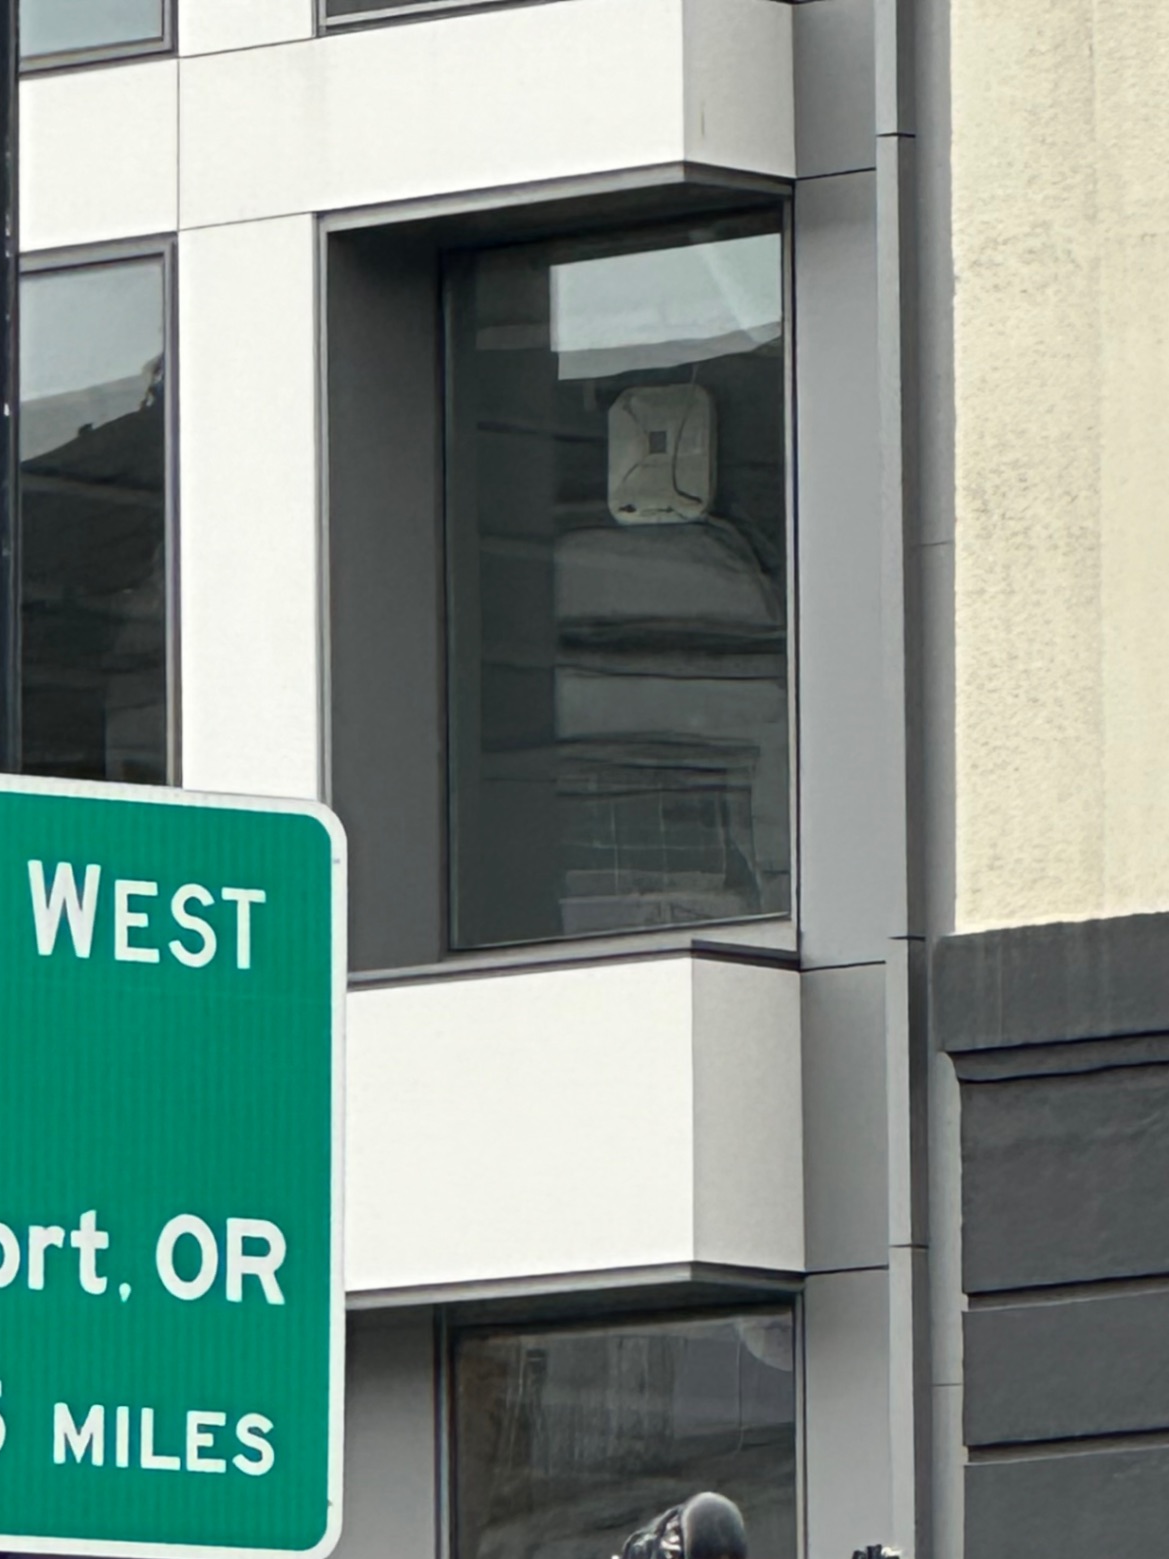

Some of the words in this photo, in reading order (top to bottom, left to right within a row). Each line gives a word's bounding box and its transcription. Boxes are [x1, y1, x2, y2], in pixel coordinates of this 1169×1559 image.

[27, 859, 266, 969] WEST
[156, 1214, 286, 1305] OR
[52, 1402, 275, 1475] MILES
